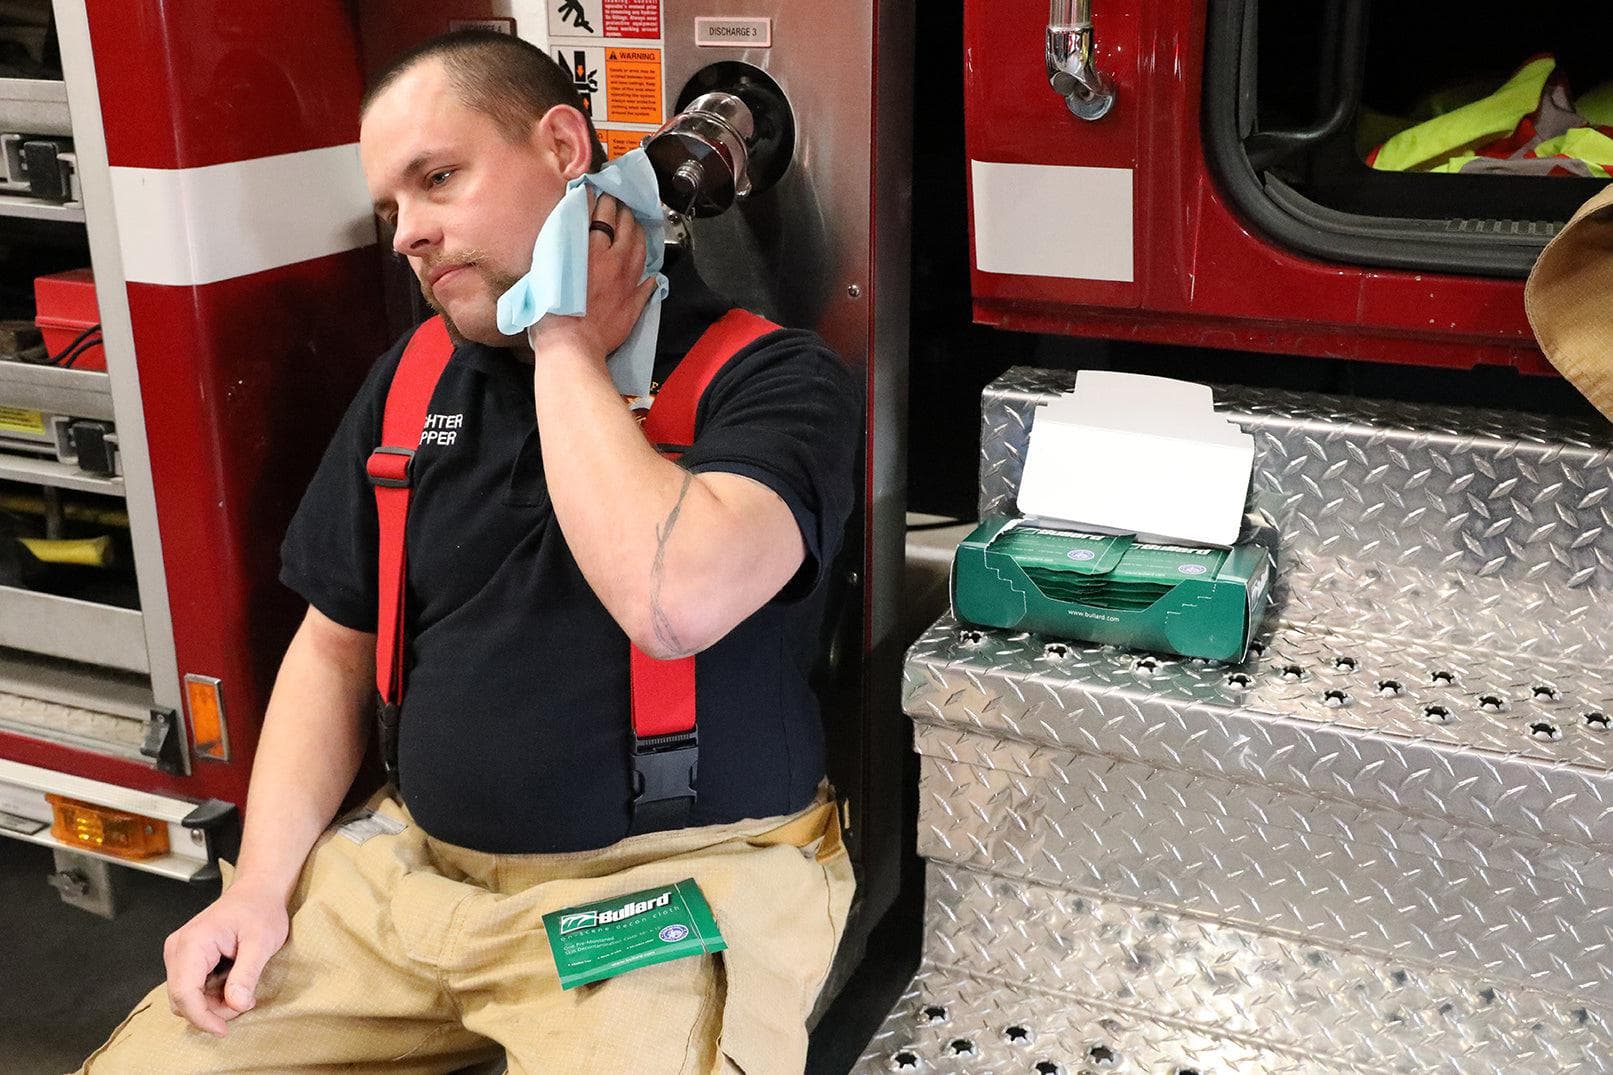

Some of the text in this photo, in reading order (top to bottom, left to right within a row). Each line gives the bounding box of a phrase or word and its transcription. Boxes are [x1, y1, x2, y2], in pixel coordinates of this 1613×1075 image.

[709, 26, 757, 37] DISCHARGE 3
[619, 52, 656, 61] WARNING
[1068, 609, 1120, 622] www.bullard.com
[599, 892, 672, 924] Bullard
[652, 906, 680, 919] cloth
